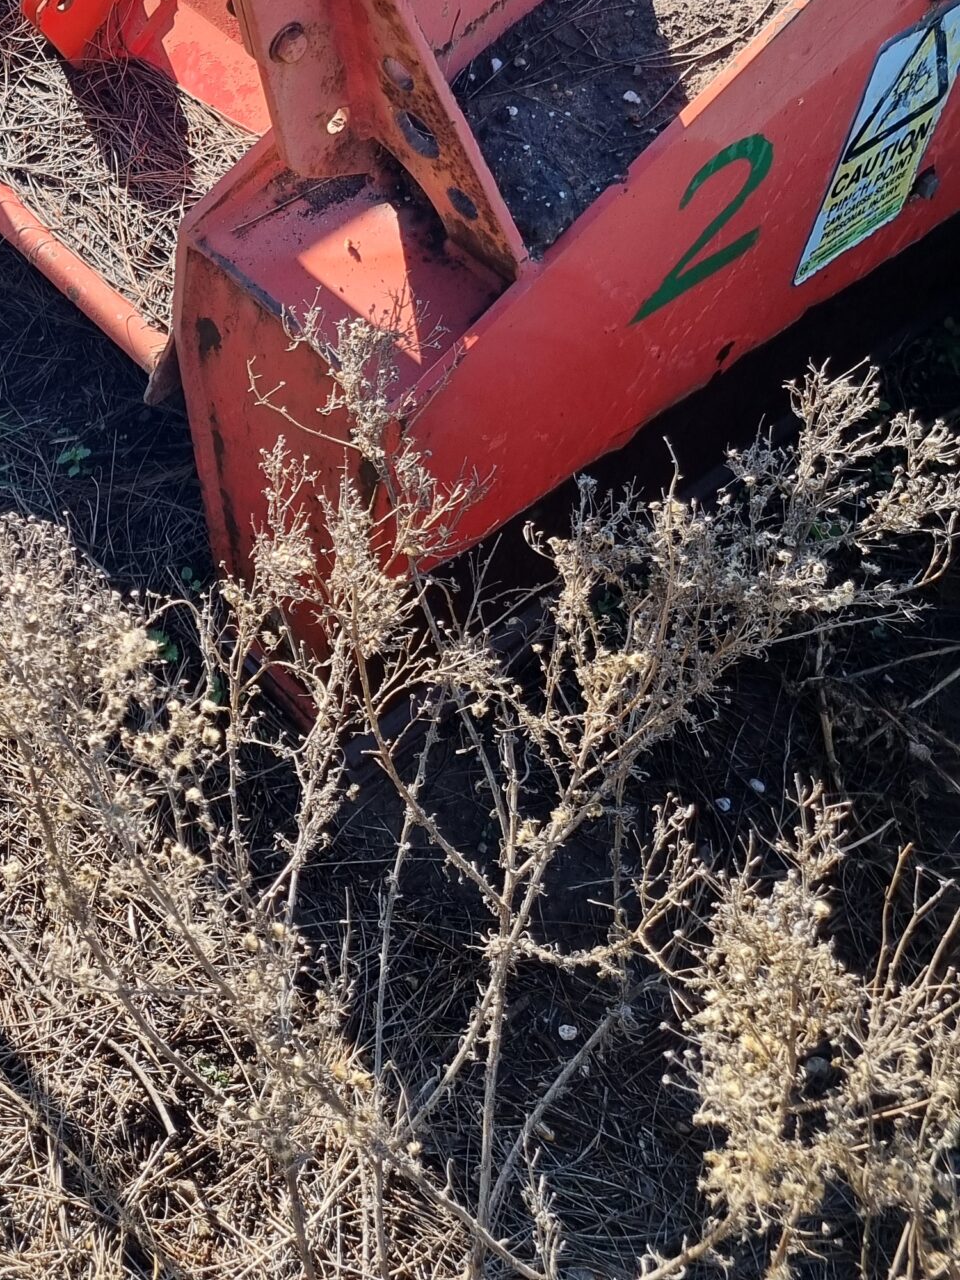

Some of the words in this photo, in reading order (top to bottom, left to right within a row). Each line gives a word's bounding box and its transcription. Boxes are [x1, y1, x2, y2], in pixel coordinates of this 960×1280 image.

[827, 180, 873, 218] PINCH
[874, 152, 915, 187] POINT
[831, 117, 933, 199] CAUTION
[628, 132, 774, 327] 2
[820, 206, 867, 243] PERSONAL
[867, 183, 901, 210] INJURY
[823, 211, 844, 230] CAN
[844, 192, 874, 217] CAUSE
[873, 169, 908, 198] SEVERE
